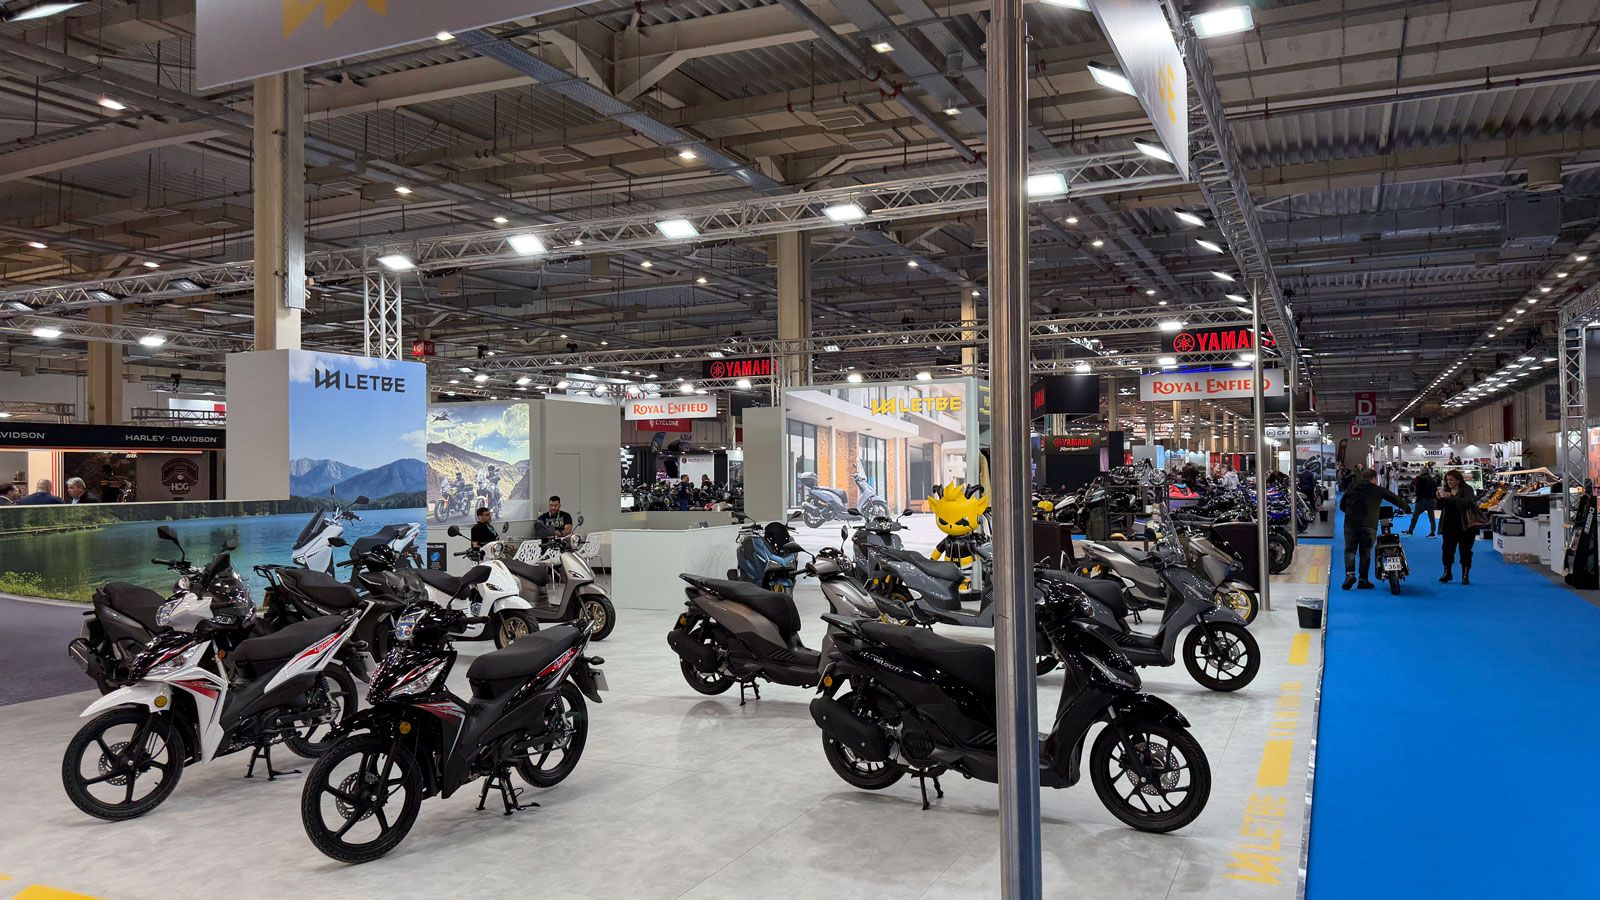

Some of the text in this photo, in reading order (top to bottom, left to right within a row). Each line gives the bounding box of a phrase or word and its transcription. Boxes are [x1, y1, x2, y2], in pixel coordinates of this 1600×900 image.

[345, 373, 405, 392] LETBE
[1152, 379, 1271, 395] ROYAL ENFIED
[633, 402, 708, 415] ROYAL ENFIELD
[899, 396, 961, 413] LETBE
[1358, 400, 1373, 415] D
[125, 434, 217, 443] HARLEY-DAVIDSON
[1062, 438, 1092, 448] YAMAHA
[622, 477, 635, 487] OGE
